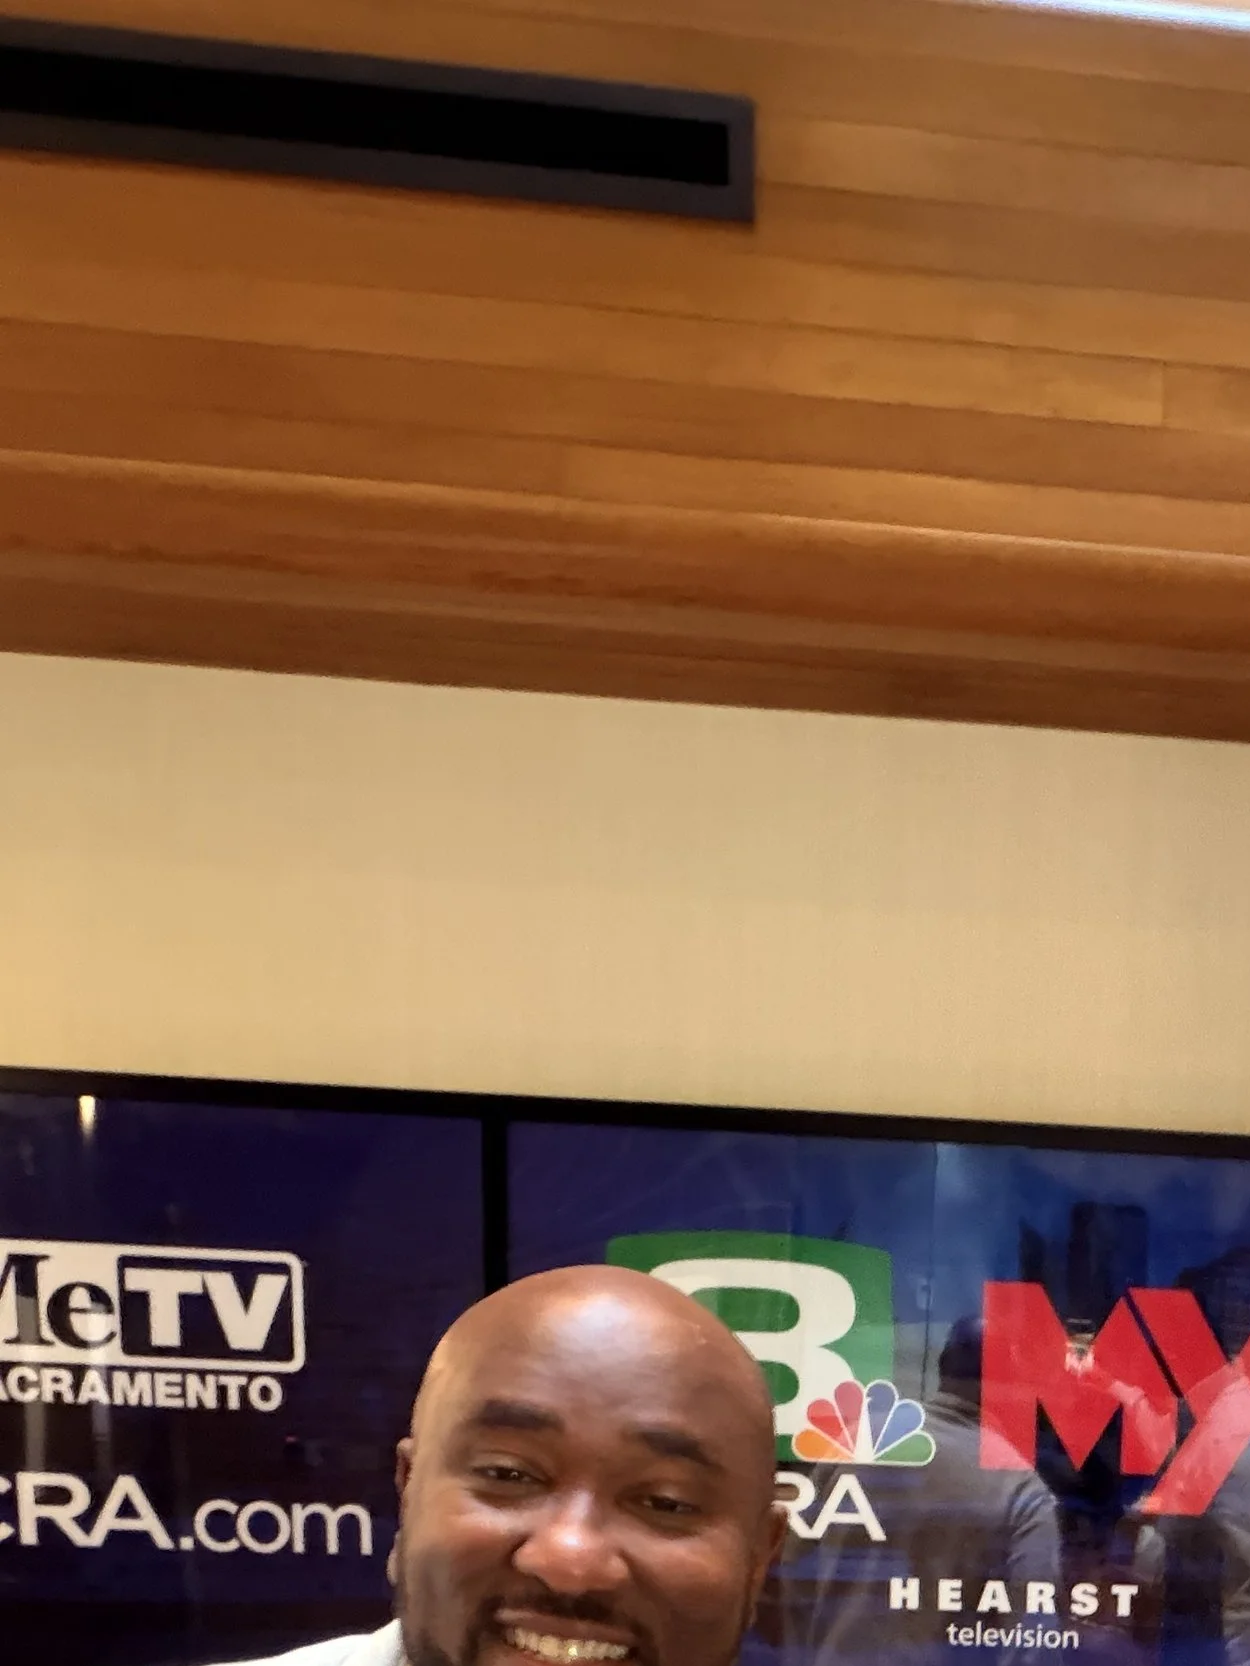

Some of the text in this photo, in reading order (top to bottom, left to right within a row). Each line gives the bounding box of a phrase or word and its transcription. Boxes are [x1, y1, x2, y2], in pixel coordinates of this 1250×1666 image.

[0, 1368, 284, 1411] CRAMENTO
[0, 1471, 374, 1556] RA.com
[889, 1577, 1139, 1617] HEARST
[946, 1620, 1080, 1649] television
